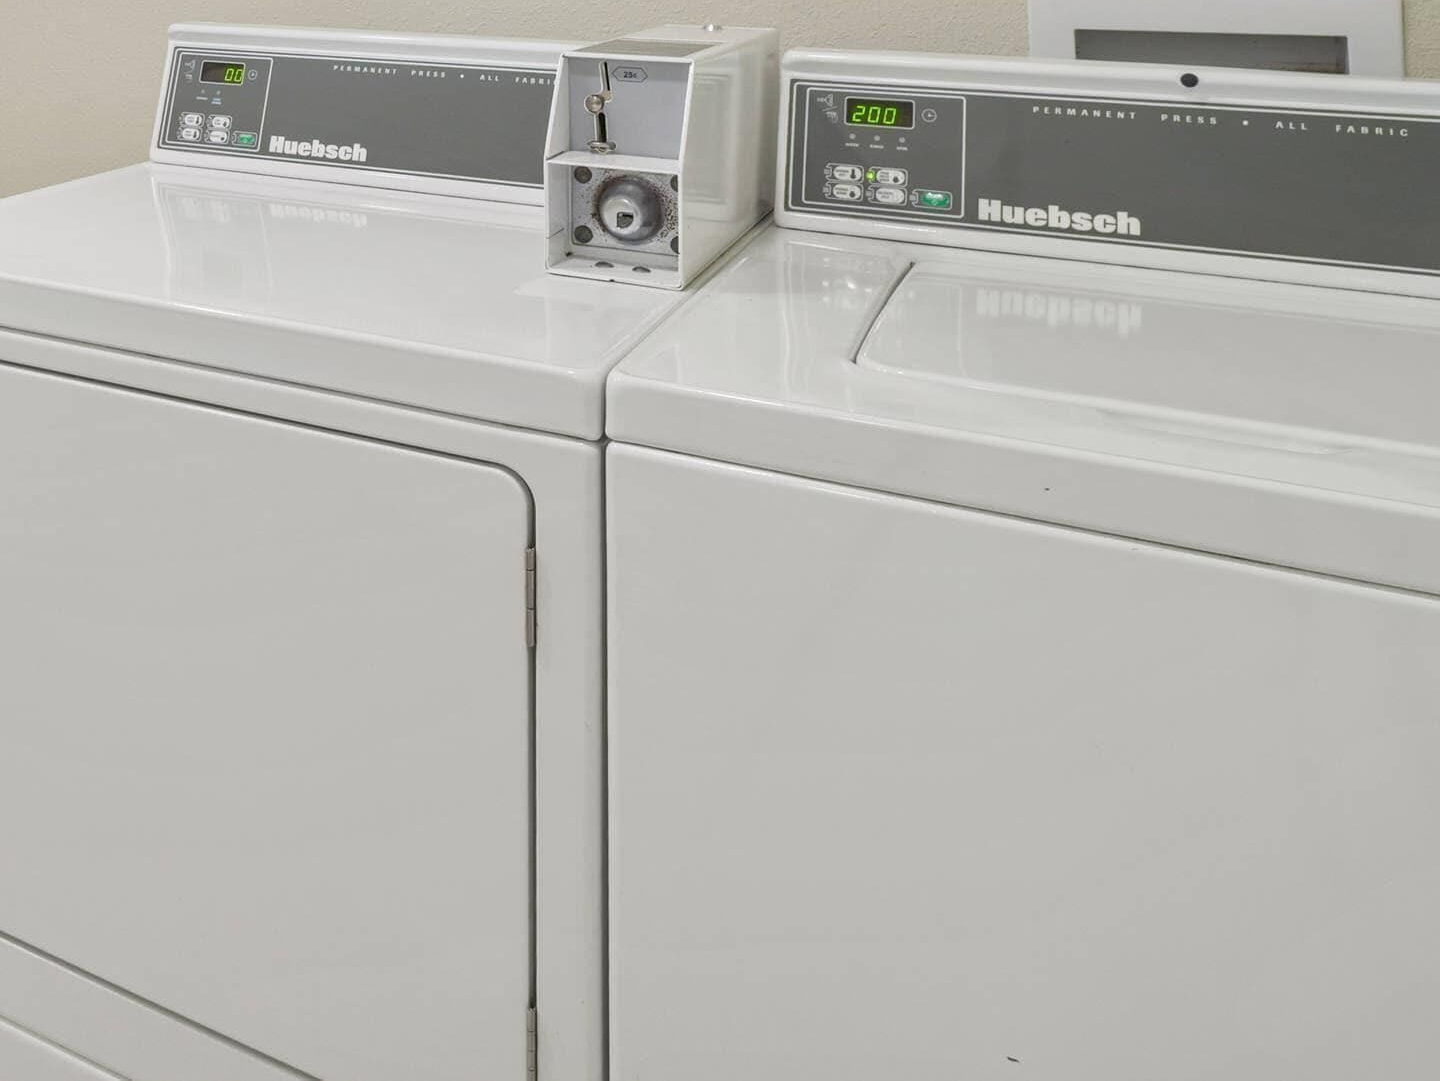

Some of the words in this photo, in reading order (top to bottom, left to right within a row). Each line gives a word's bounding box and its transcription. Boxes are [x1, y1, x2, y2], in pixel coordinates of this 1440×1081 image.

[333, 64, 398, 76] PERMANENT
[411, 69, 446, 79] PRESS
[479, 74, 500, 82] ALL
[852, 105, 897, 125] 200
[1032, 106, 1137, 120] PERMANENT
[1161, 113, 1218, 126] PRESS
[1275, 121, 1308, 131] ALL
[1335, 124, 1409, 138] FABRIC
[268, 135, 368, 162] Huebsch
[977, 198, 1141, 236] Huebsch
